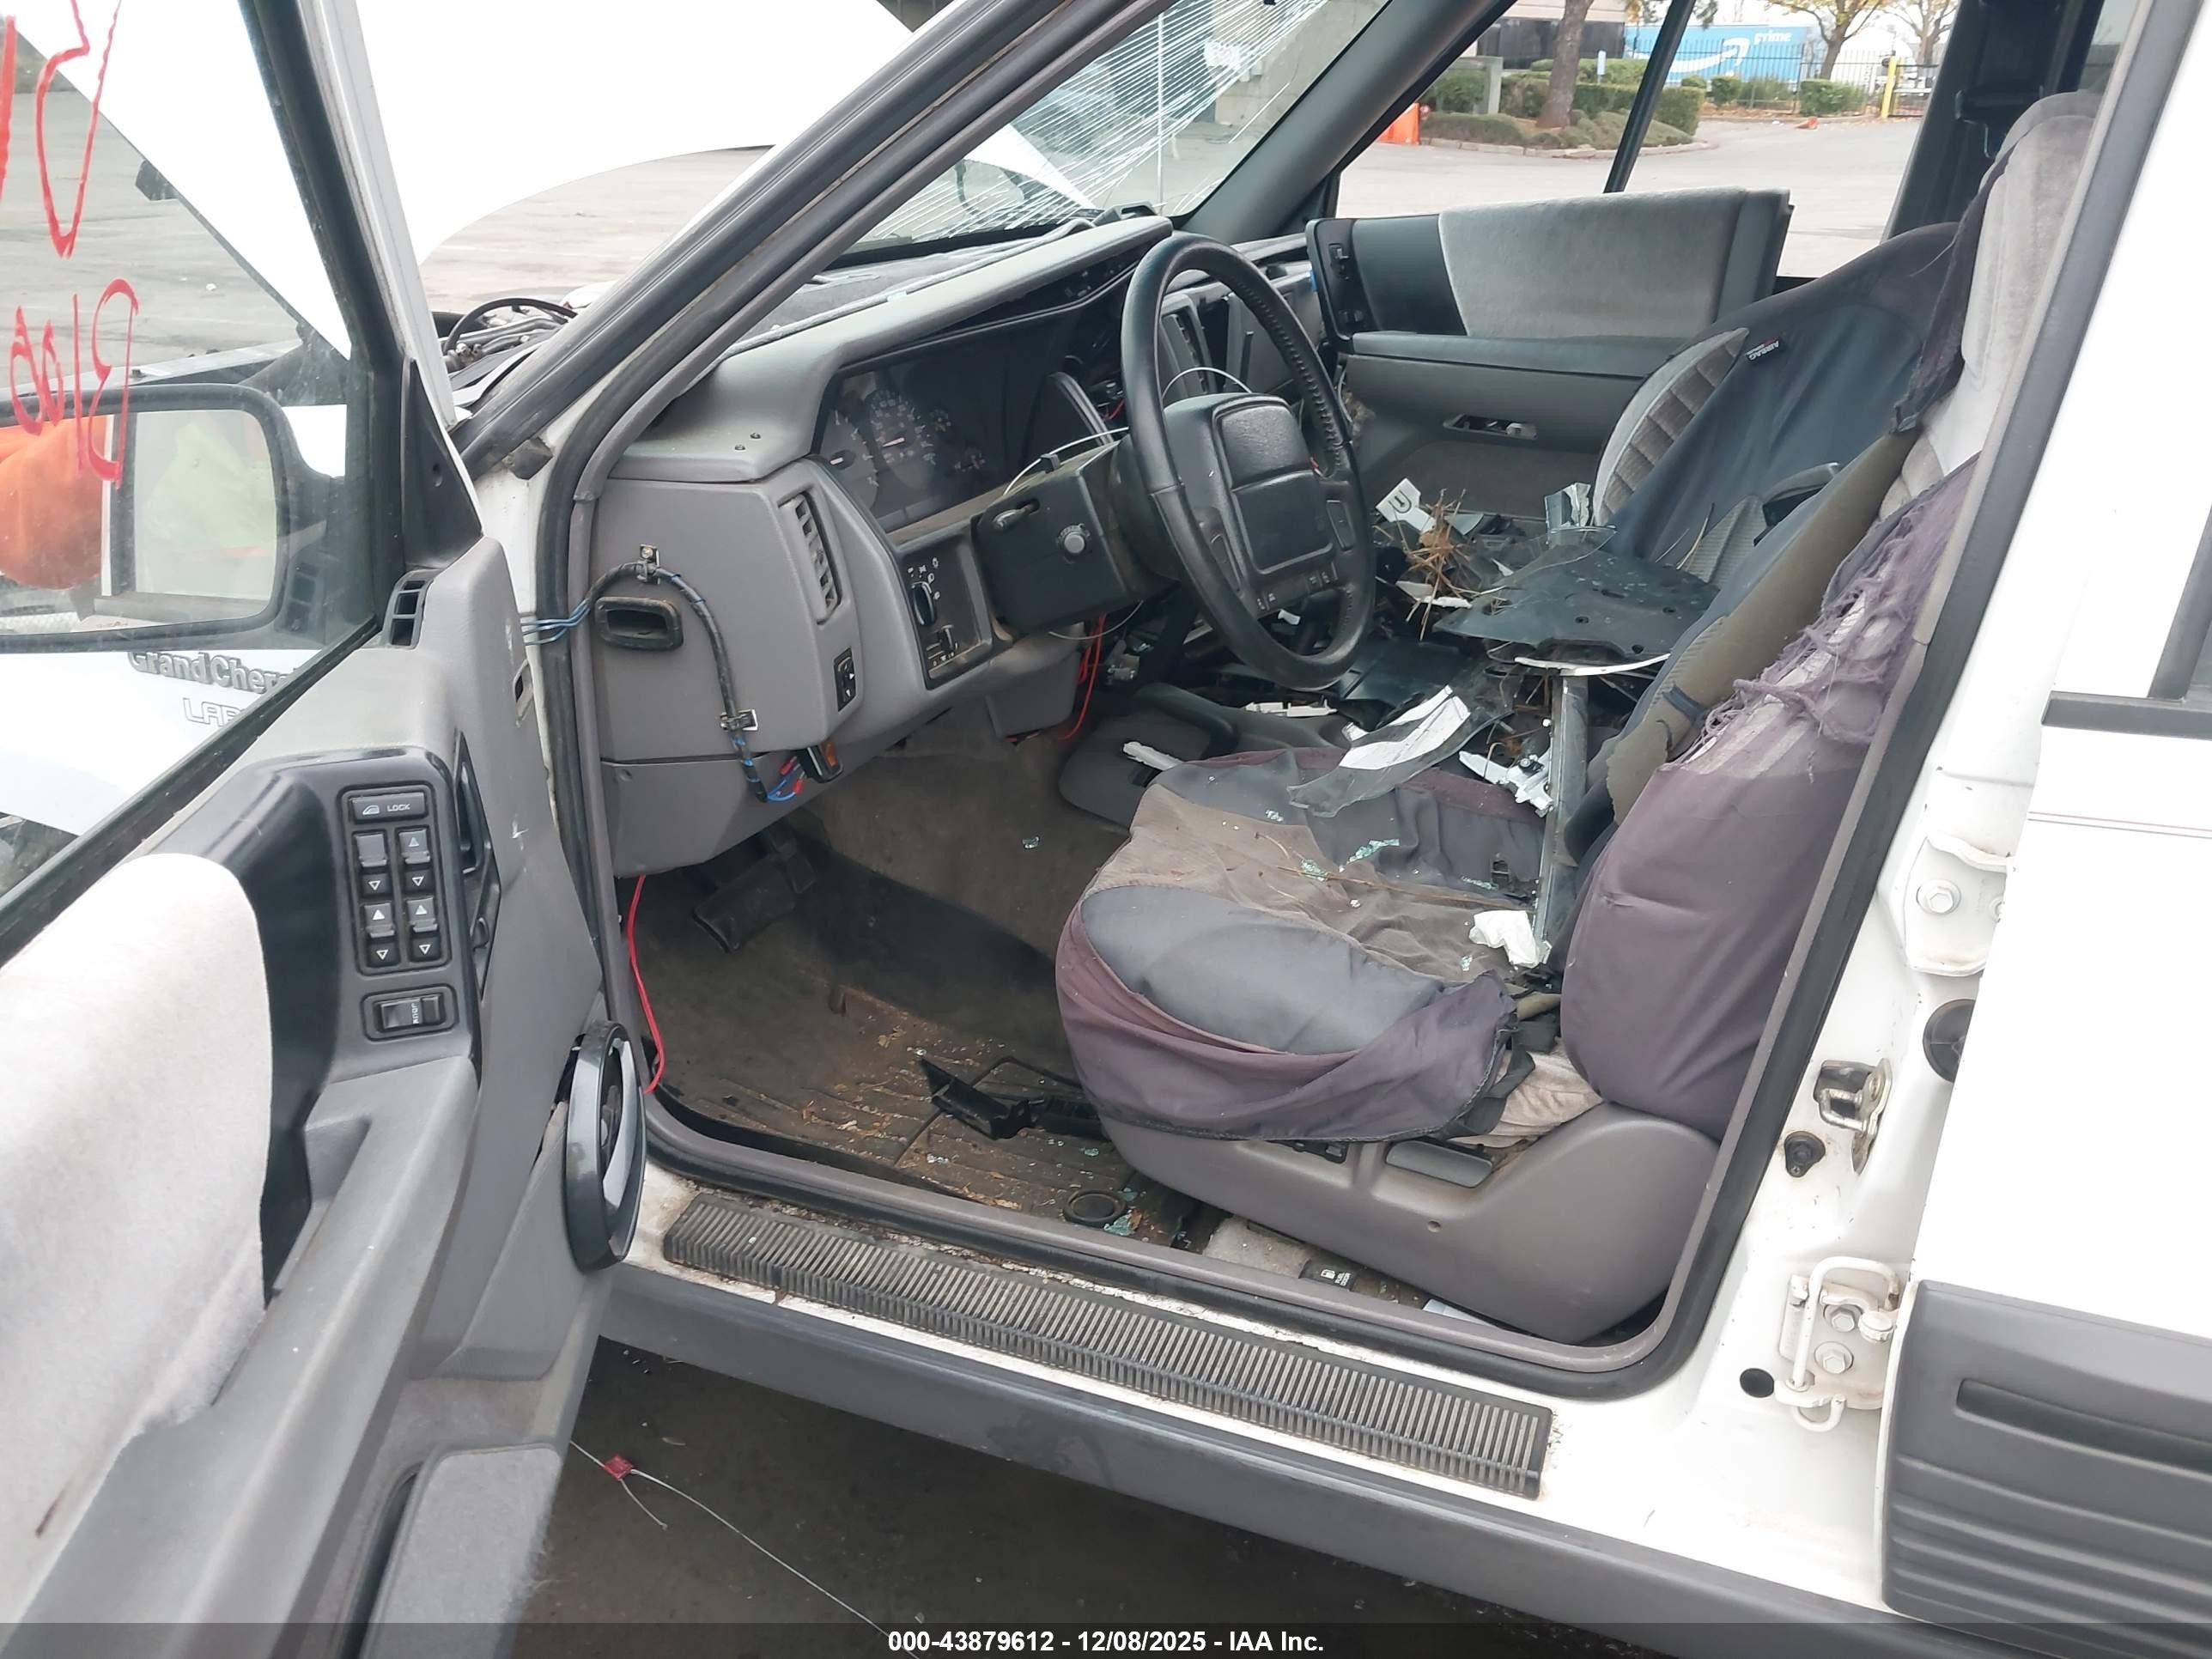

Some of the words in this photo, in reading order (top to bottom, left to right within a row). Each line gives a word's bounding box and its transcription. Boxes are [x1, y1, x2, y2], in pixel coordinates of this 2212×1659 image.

[1753, 29, 1792, 46] prime
[128, 652, 214, 685] Grand
[386, 803, 410, 812] LOCK
